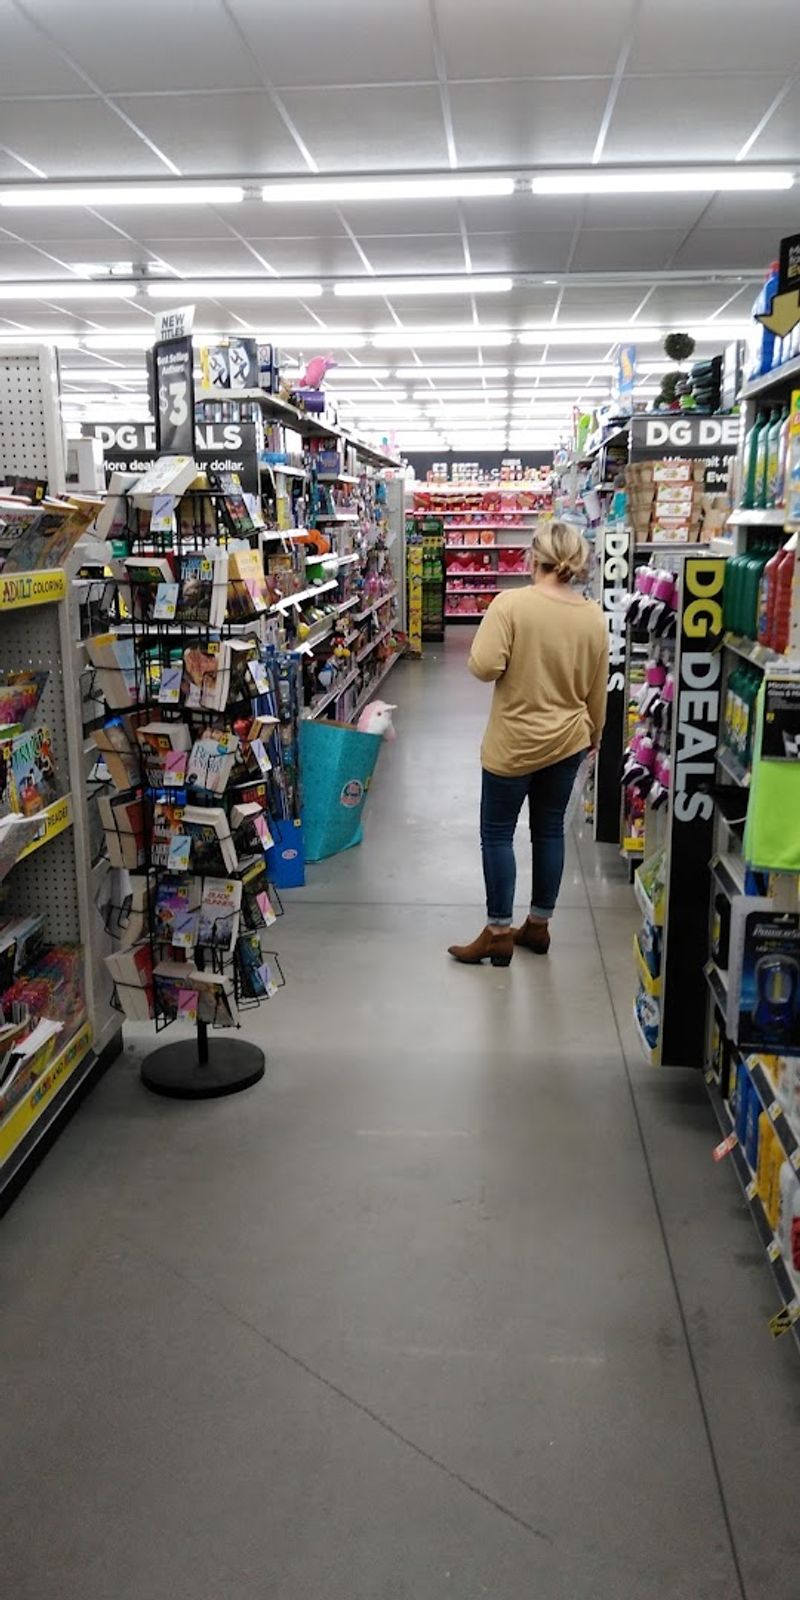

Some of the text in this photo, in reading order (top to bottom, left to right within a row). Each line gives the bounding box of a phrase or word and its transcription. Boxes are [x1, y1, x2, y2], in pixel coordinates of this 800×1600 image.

[162, 313, 186, 329] NEW
[160, 326, 185, 341] TITLES
[94, 425, 139, 450] DG
[645, 419, 693, 447] DG
[210, 459, 245, 471] dollar.
[604, 533, 630, 581] DG
[3, 579, 64, 603] ADULT COLORING
[674, 559, 727, 823] DG DEALS
